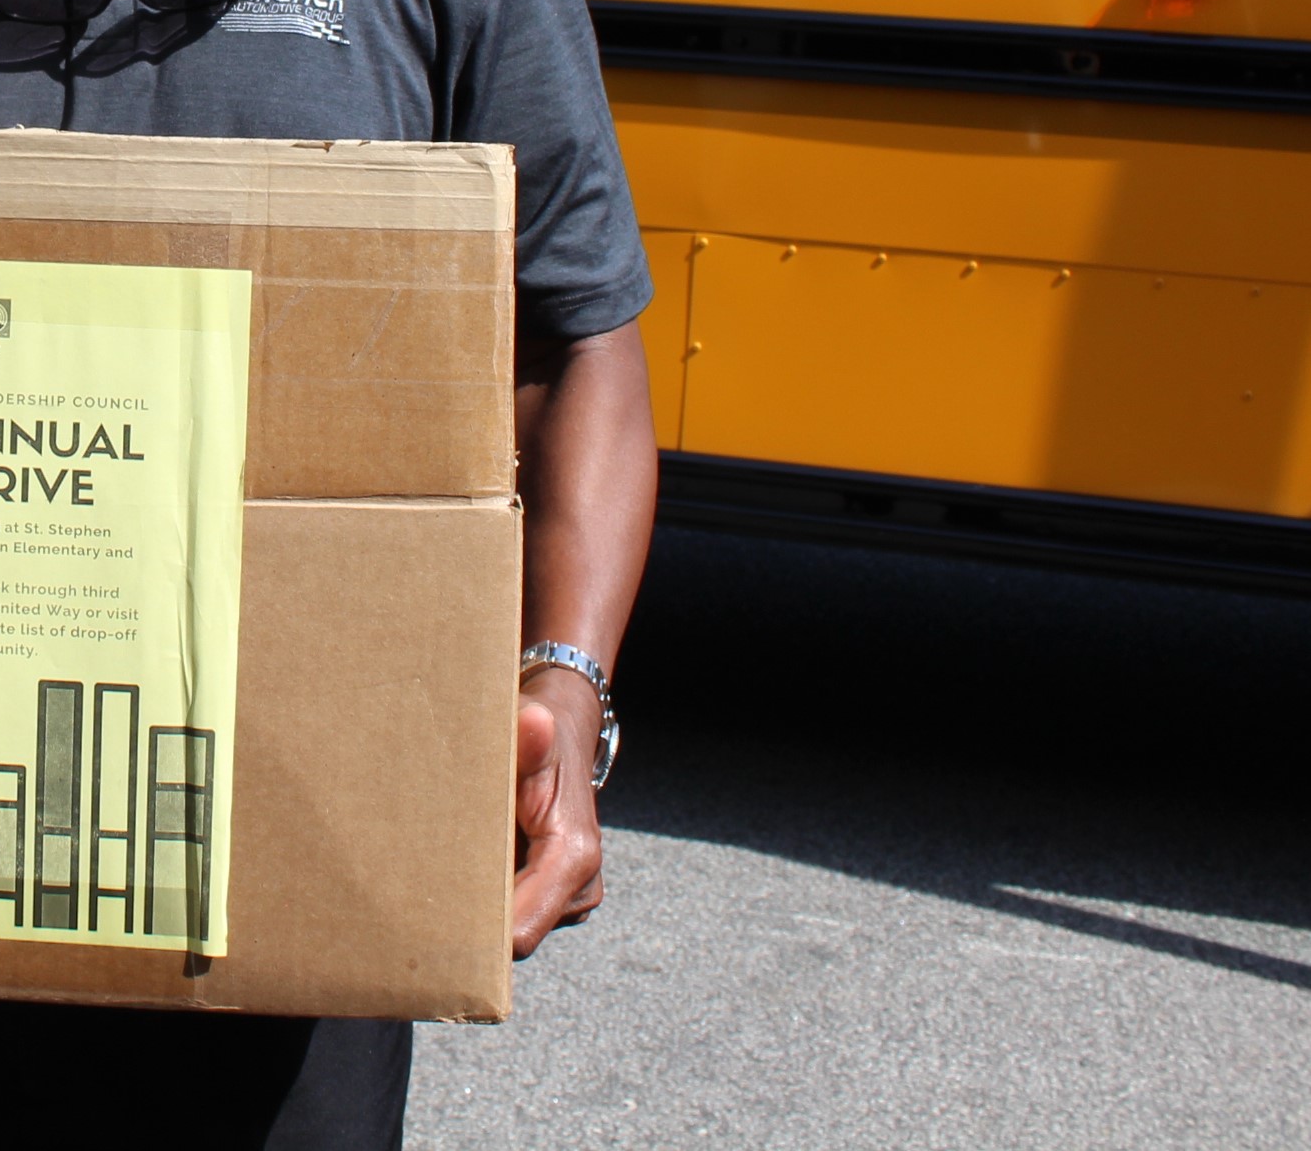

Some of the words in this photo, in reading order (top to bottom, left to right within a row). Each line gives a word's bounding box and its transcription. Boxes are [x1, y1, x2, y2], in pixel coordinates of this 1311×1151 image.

[304, 6, 345, 23] GROUP
[73, 396, 148, 410] COUNCIL
[5, 523, 19, 533] at
[25, 523, 42, 534] St.
[49, 524, 110, 538] Stephen
[14, 542, 100, 560] Elementary
[105, 547, 133, 558] and
[15, 583, 76, 599] through
[83, 586, 119, 598] third
[47, 604, 80, 620] Way
[86, 609, 101, 618] or
[107, 608, 138, 620] visit
[21, 623, 44, 636] list
[50, 625, 65, 636] of
[71, 626, 137, 642] drop-off
